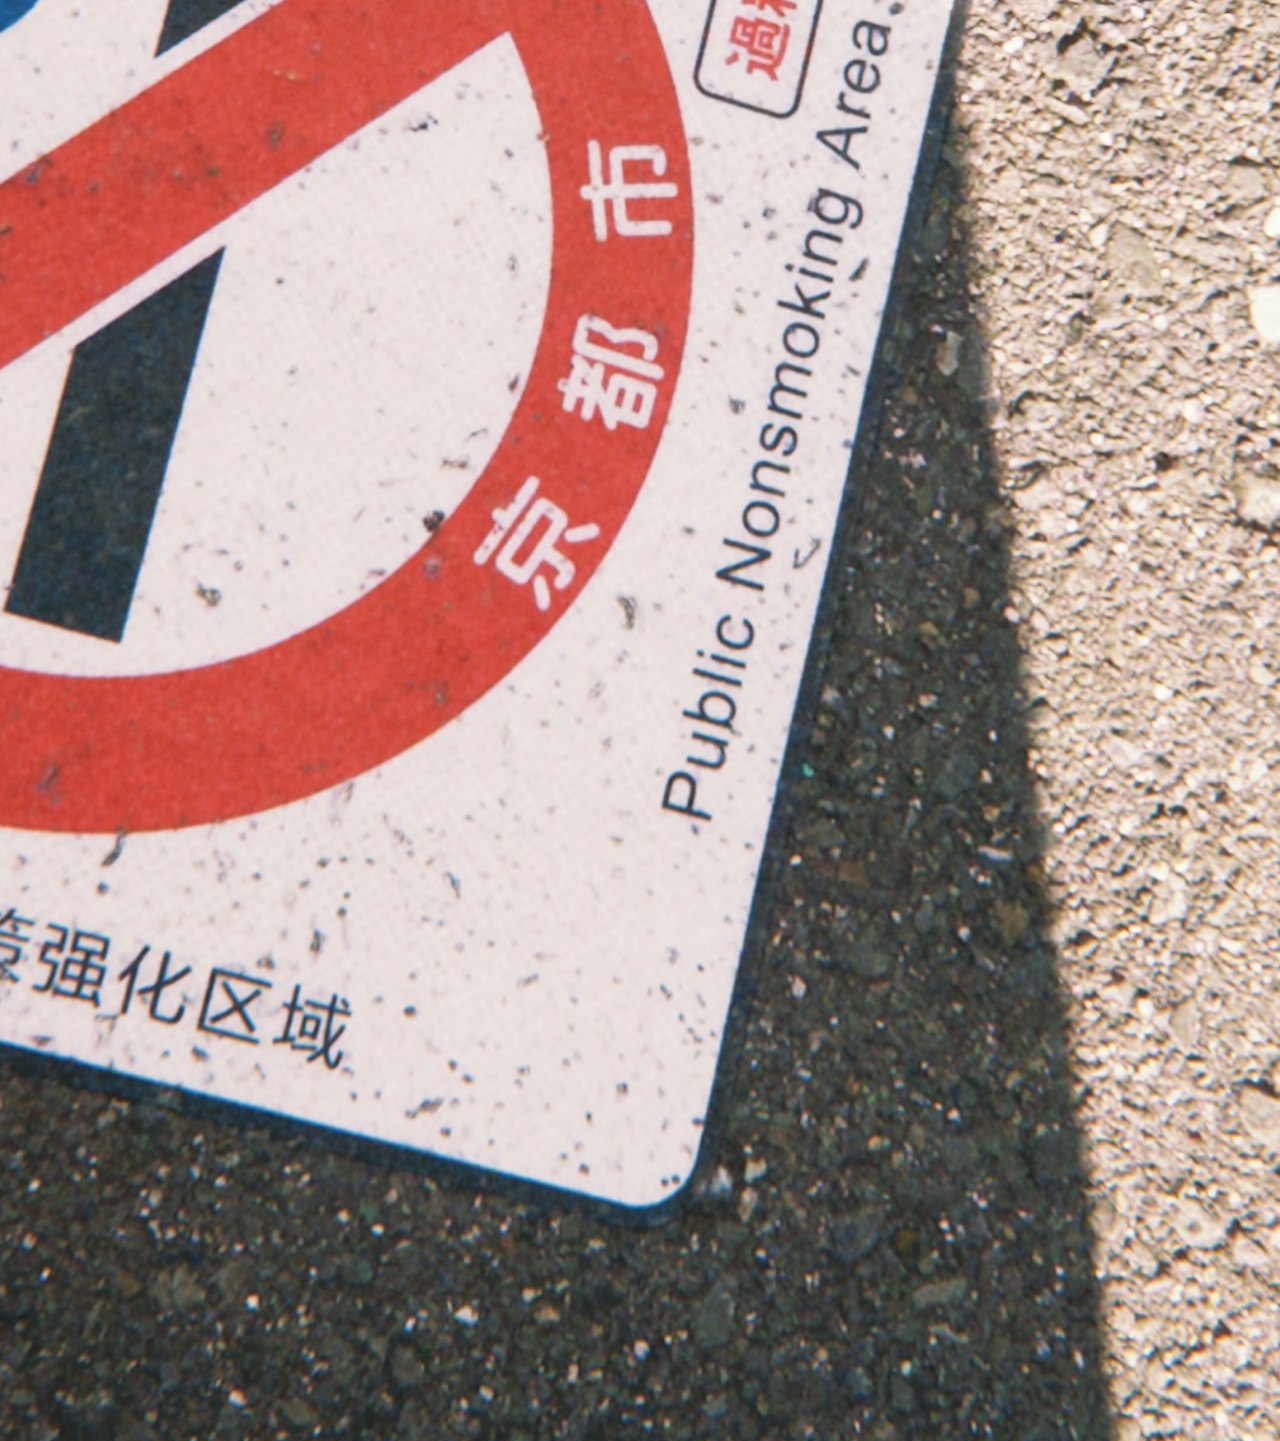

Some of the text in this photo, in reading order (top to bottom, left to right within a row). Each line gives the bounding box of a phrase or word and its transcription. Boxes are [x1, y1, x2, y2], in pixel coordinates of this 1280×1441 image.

[474, 140, 679, 610] 京都市
[662, 613, 754, 821] Public
[715, 186, 865, 591] Nonsmoking
